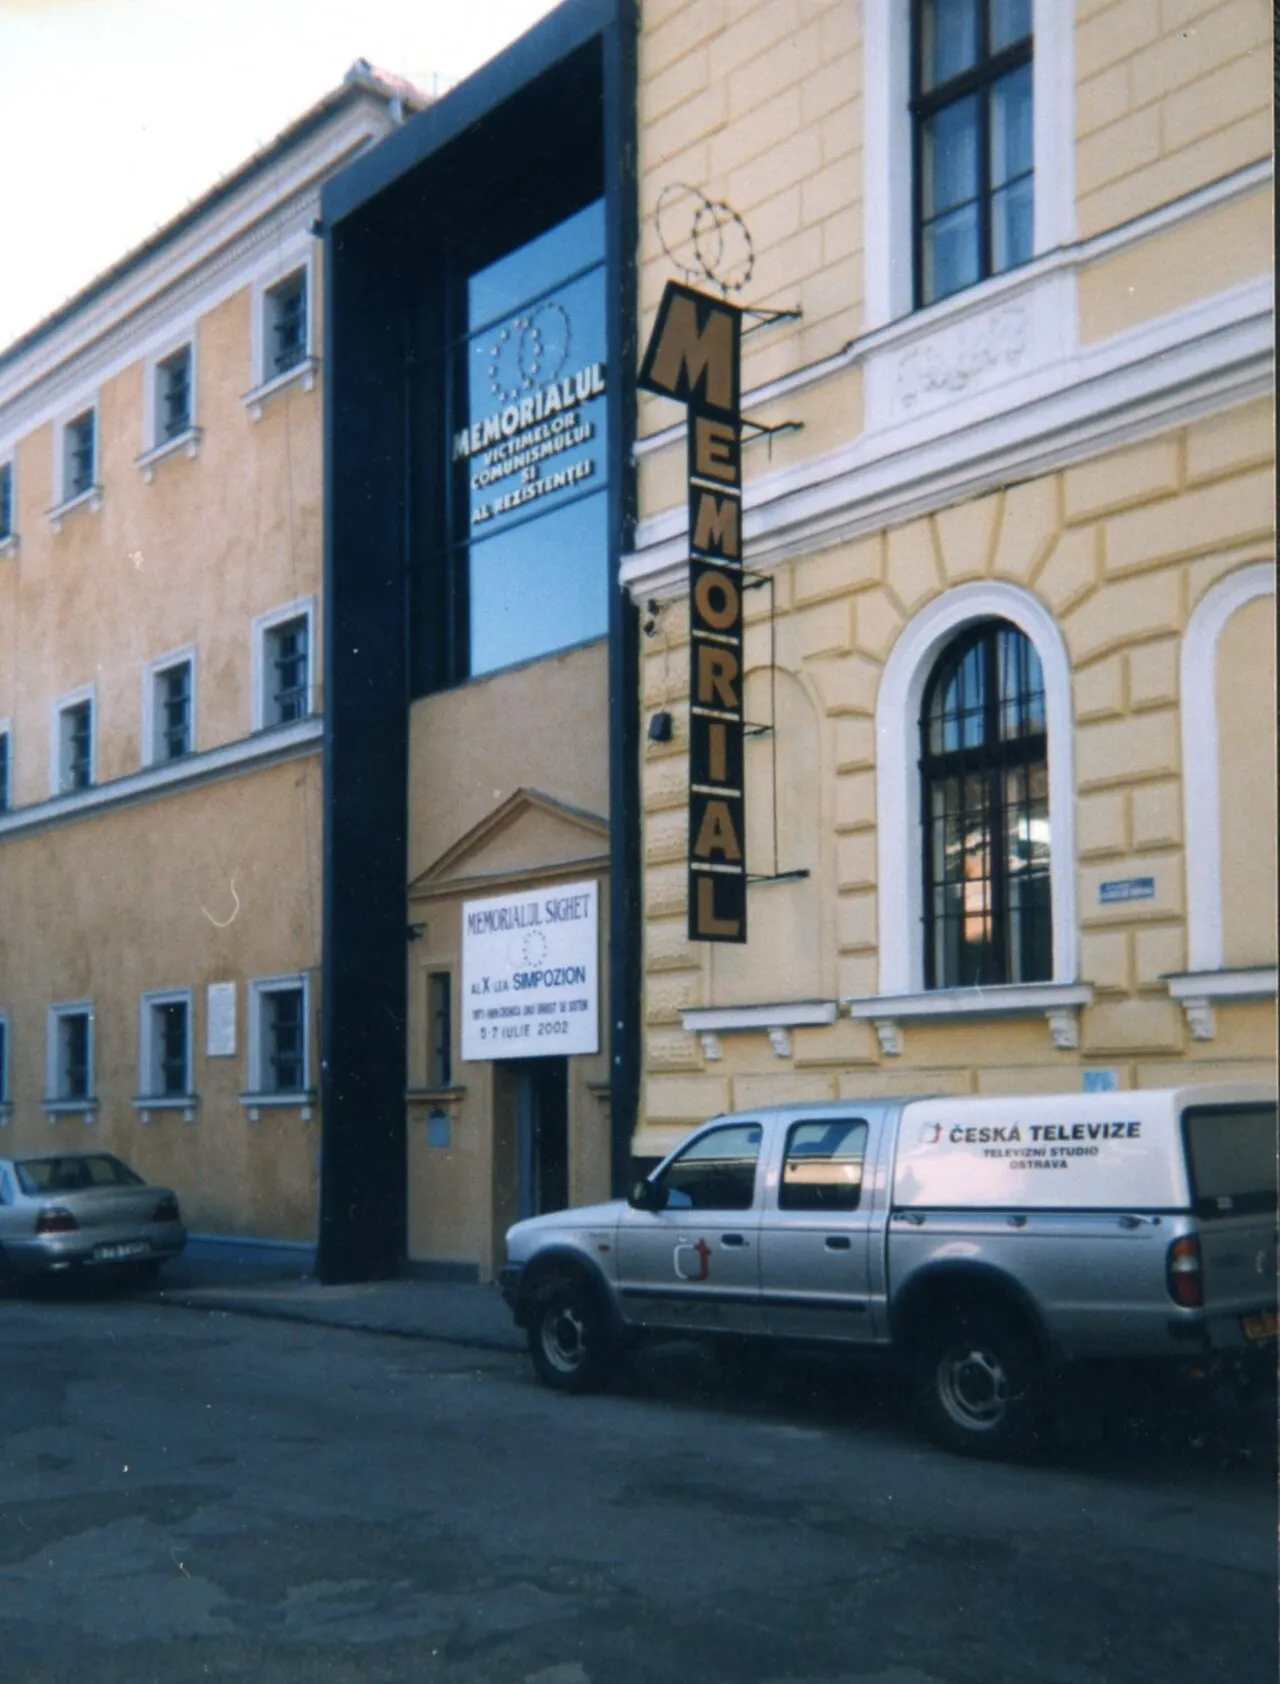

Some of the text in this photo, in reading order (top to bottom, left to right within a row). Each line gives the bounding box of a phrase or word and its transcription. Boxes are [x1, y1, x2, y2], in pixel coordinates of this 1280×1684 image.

[453, 362, 606, 462] MEMORIALUL
[483, 411, 577, 467] VICTIMELOR
[470, 421, 592, 490] COMUNISMULUI
[471, 503, 489, 523] AL
[649, 292, 742, 937] MEMORIAL
[467, 893, 591, 936] MEMORIALUL SIGHET
[512, 965, 586, 991] SIMPOZION
[501, 1023, 531, 1039] IULIE
[537, 1019, 569, 1036] 2002
[949, 1122, 1021, 1144] ČESKÁ
[1030, 1121, 1141, 1142] TELEVIZE
[1050, 1145, 1099, 1157] STUDIO
[1009, 1159, 1068, 1170] OSTRAVA
